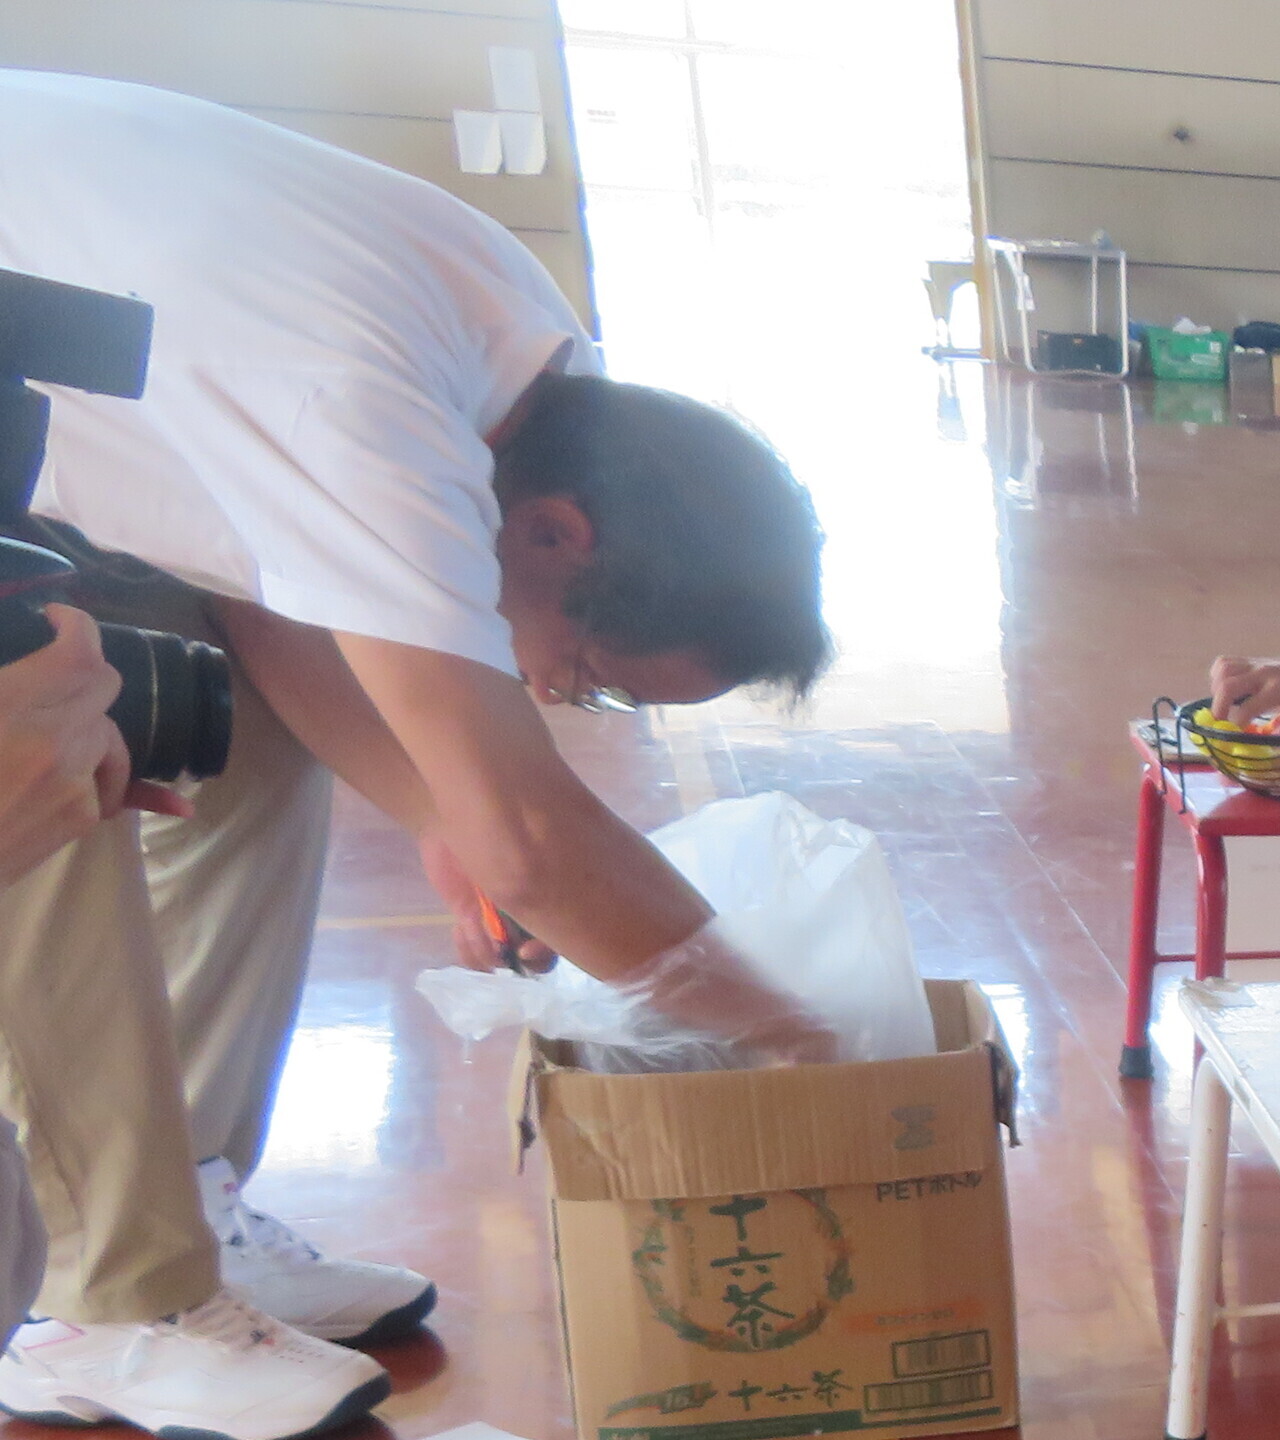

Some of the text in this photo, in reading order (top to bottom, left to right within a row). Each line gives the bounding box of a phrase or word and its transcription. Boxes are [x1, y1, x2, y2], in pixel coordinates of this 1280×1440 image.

[709, 1195, 796, 1349] 十六茶
[728, 1369, 853, 1411] 十六茶
